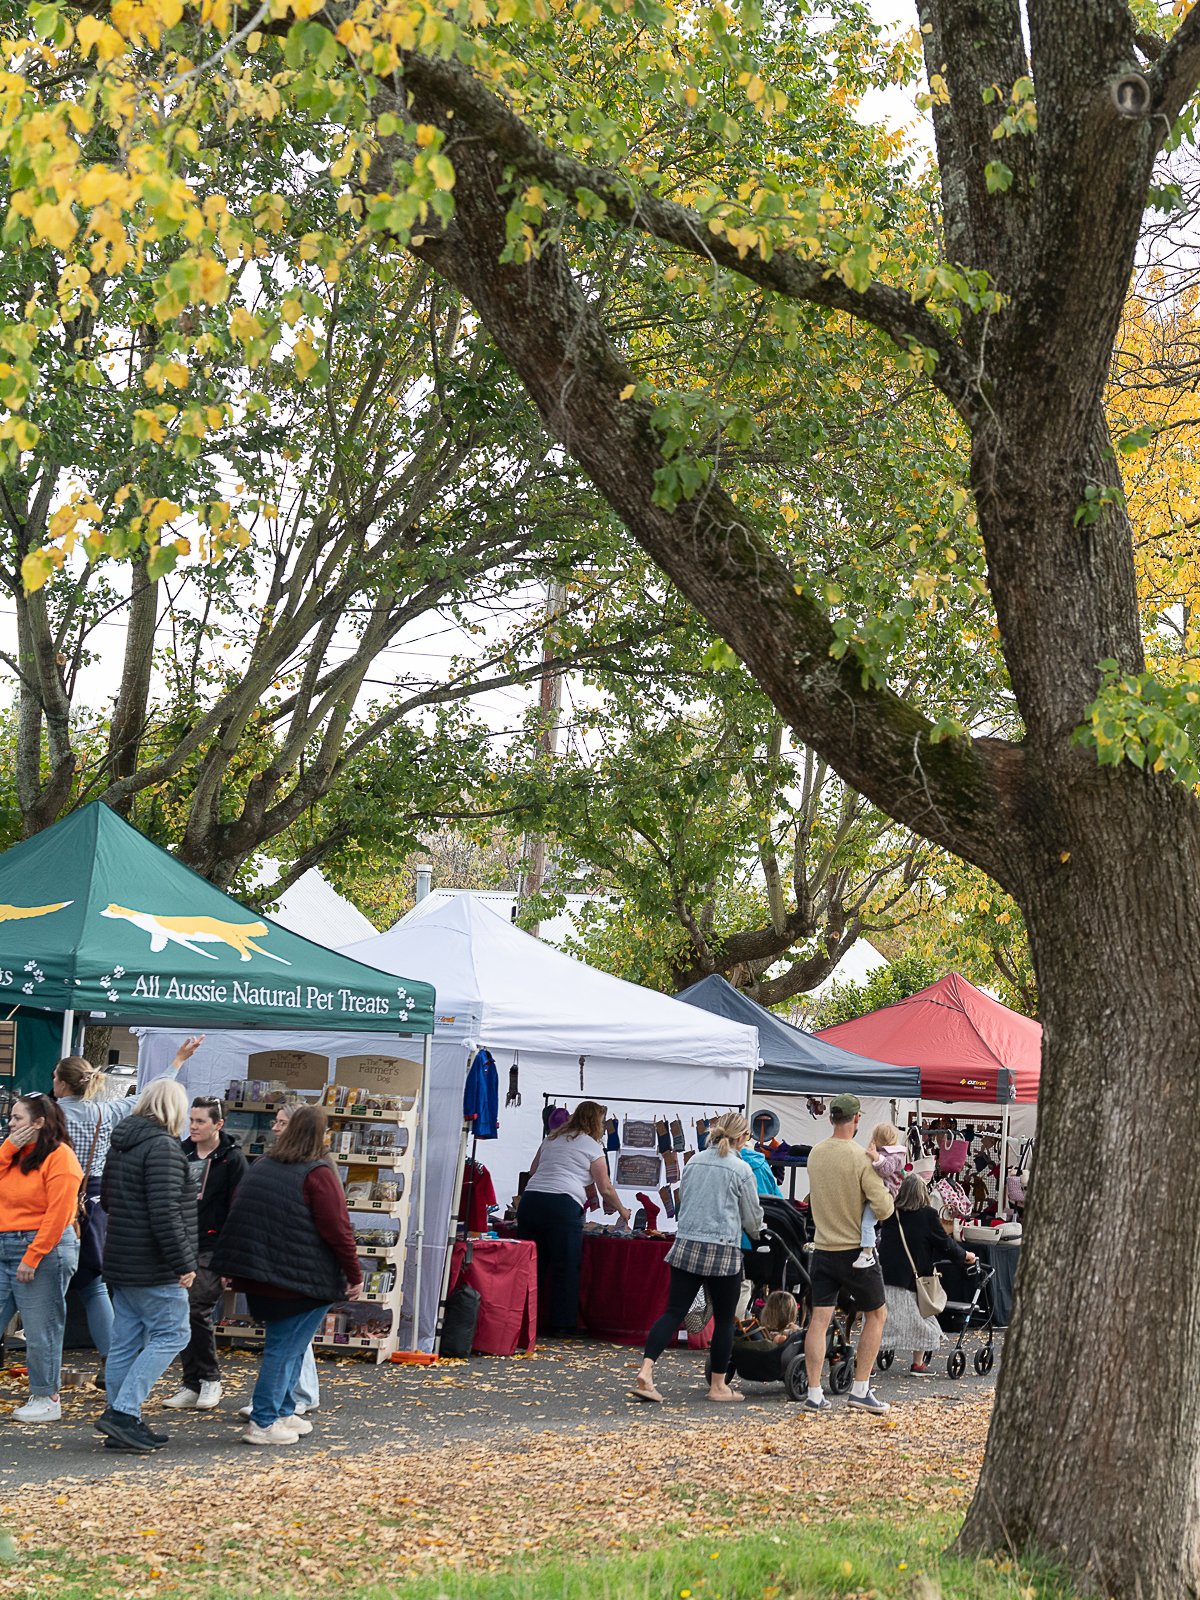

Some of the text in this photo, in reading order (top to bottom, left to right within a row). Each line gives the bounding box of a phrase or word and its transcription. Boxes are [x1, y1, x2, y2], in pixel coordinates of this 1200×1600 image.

[131, 974, 389, 1015] All Aussie Natural Pet Treats
[358, 1063, 400, 1076] Farmer's
[376, 1075, 391, 1084] Dog
